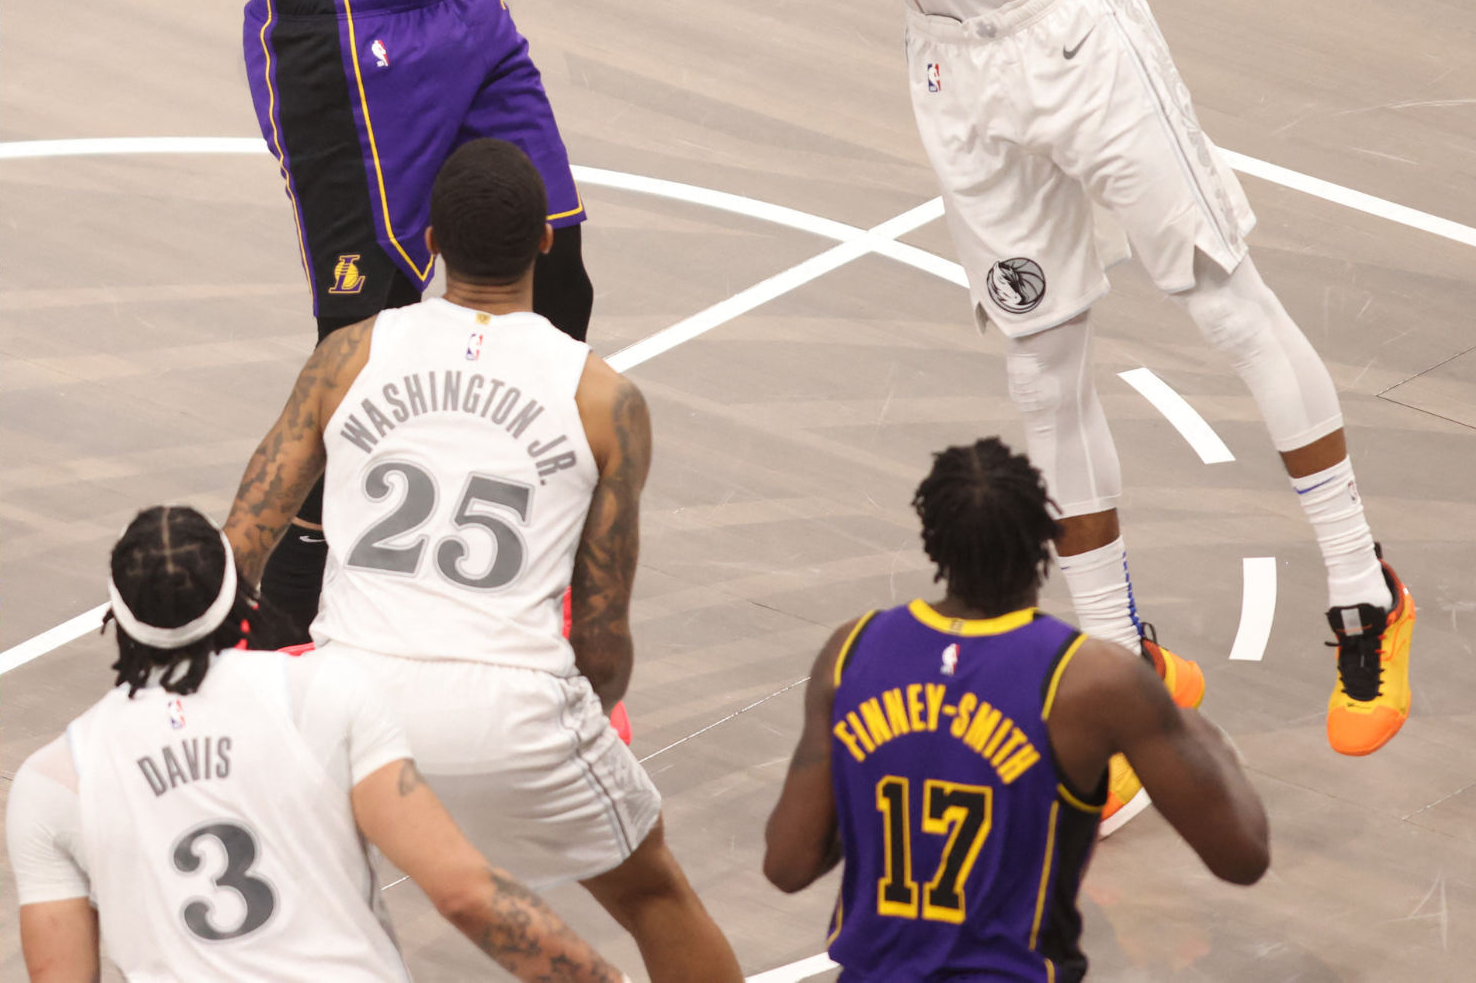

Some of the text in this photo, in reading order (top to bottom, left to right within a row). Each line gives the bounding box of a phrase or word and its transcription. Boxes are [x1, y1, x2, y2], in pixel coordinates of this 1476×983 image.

[339, 370, 577, 486] WASHINGTON JR.
[342, 459, 536, 592] 25
[137, 736, 232, 797] DAVIS
[833, 682, 1042, 785] FINNEY-SMITH
[170, 820, 280, 944] 3
[875, 774, 994, 925] 17
